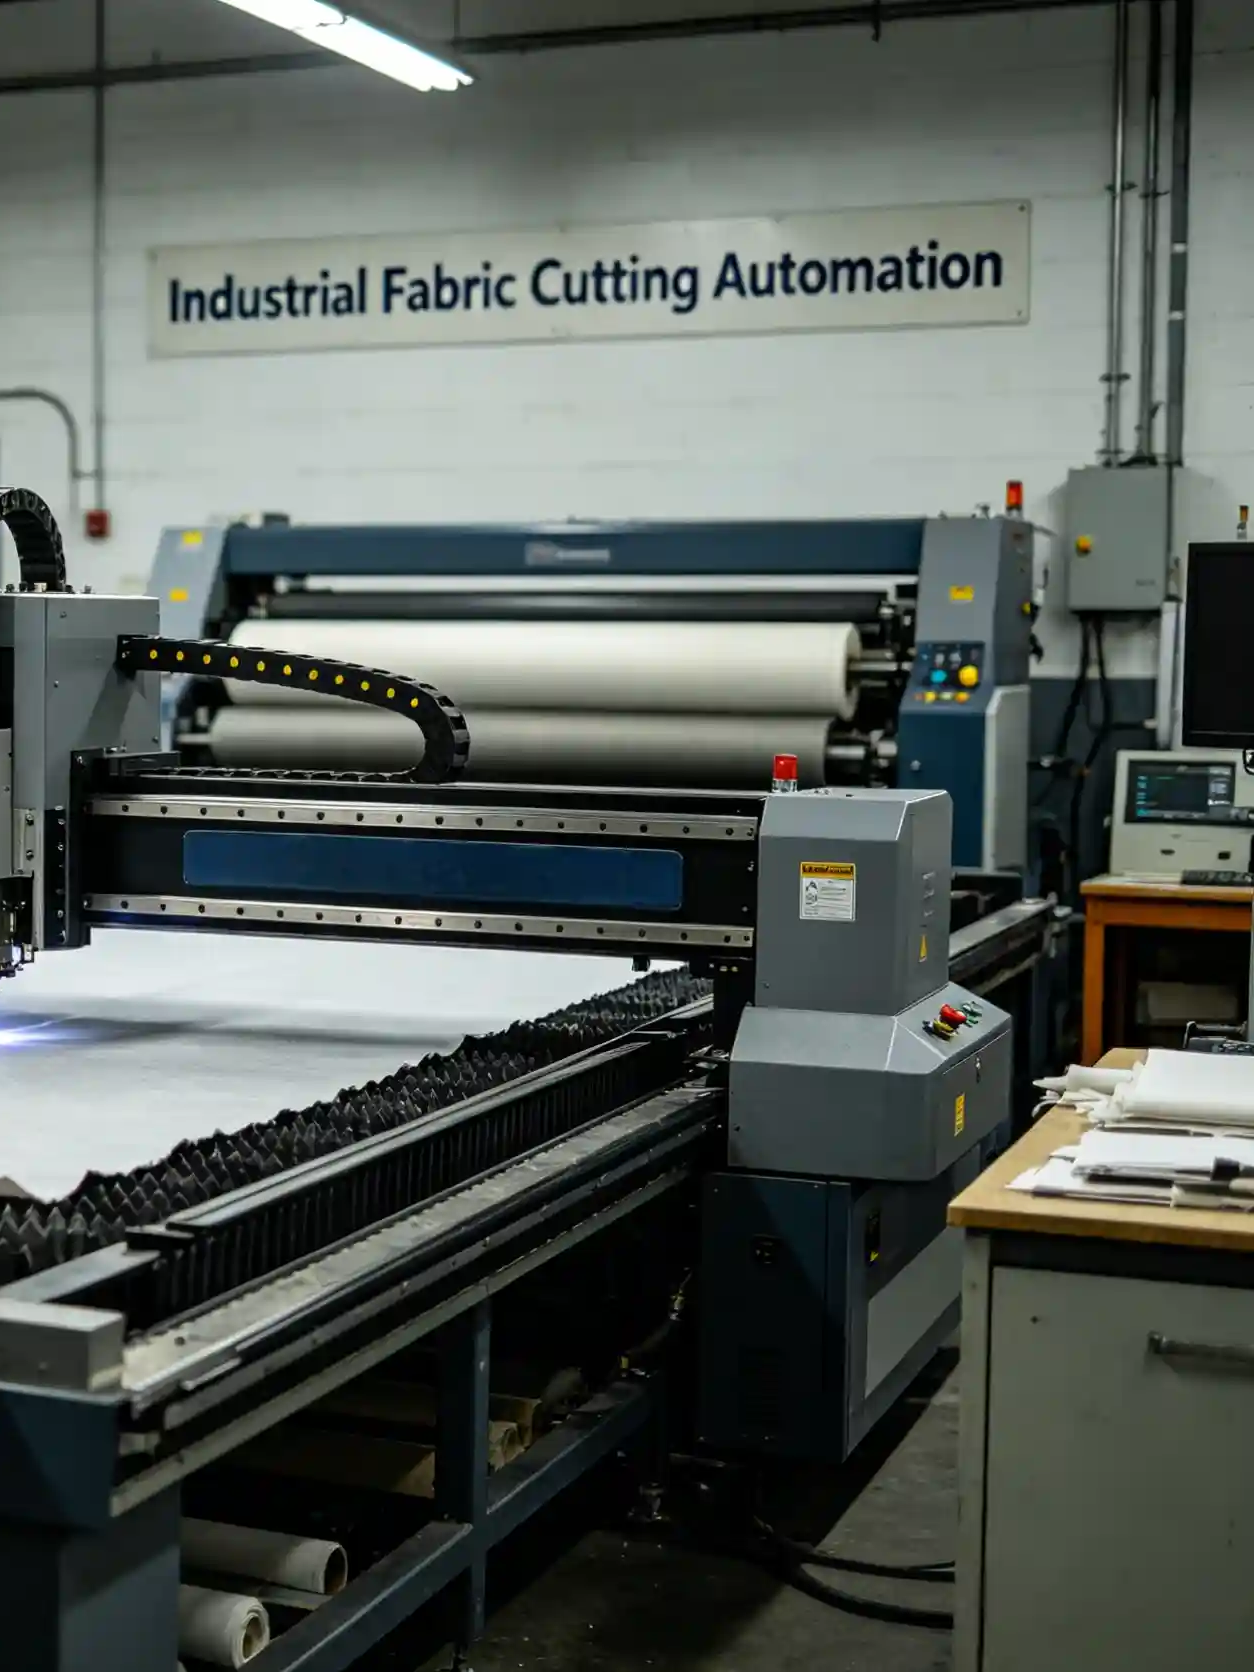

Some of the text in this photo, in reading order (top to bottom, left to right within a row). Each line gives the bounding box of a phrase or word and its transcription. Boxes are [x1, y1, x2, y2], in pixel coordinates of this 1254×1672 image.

[169, 238, 1004, 323] Industrial Fabric Cutting Automation
